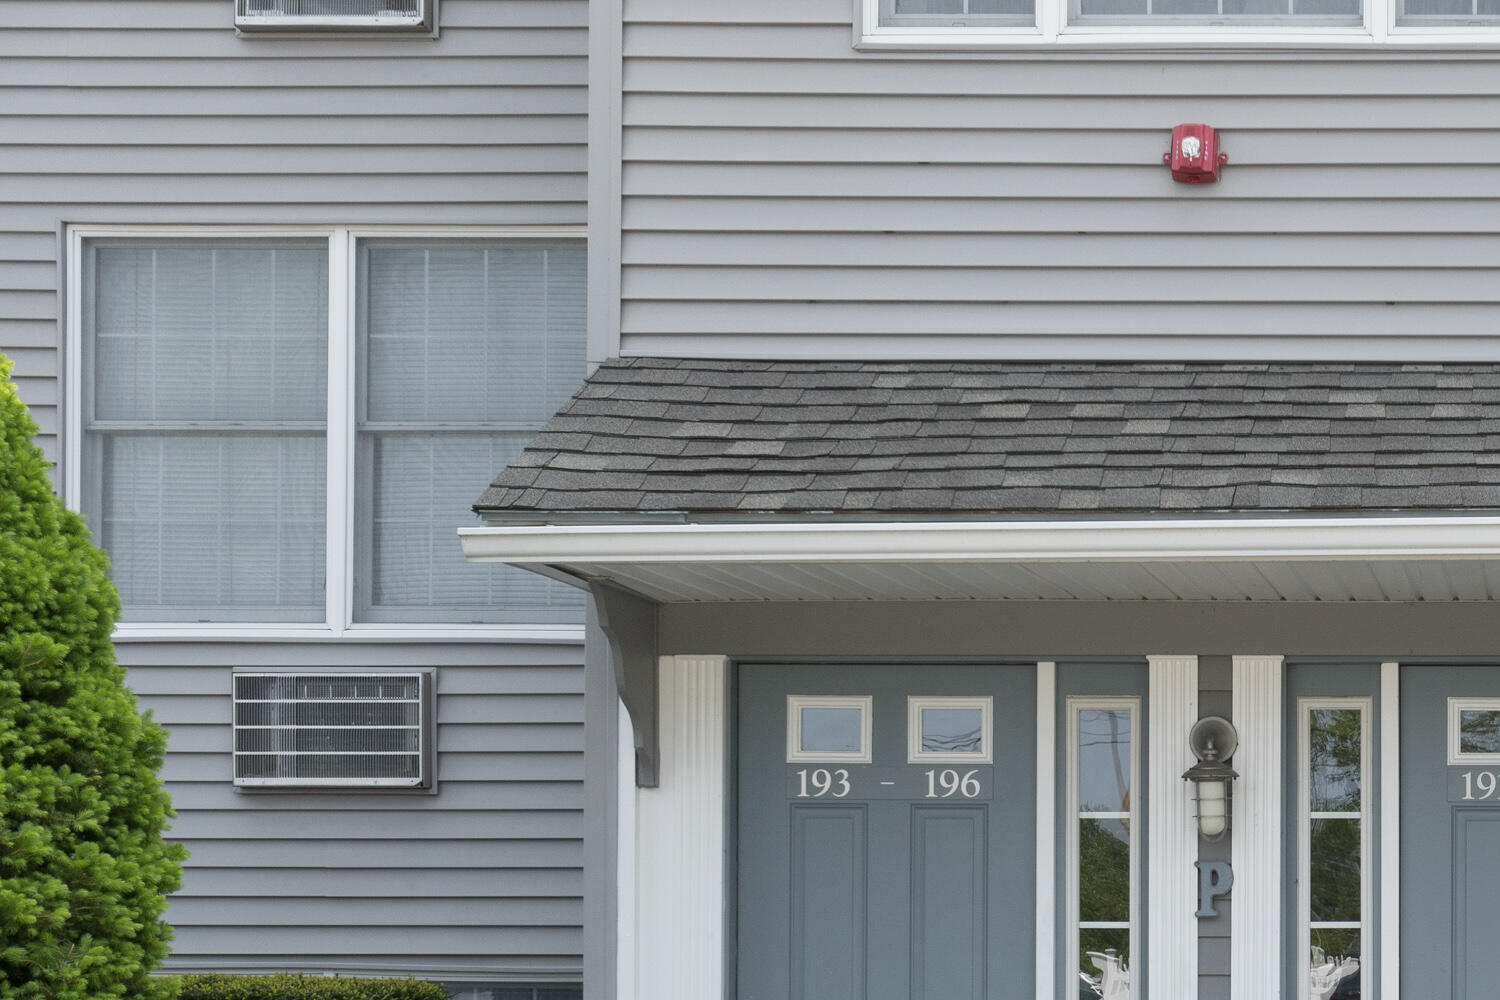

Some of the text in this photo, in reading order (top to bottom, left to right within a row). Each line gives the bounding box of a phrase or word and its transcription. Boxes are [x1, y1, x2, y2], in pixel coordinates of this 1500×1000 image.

[796, 768, 851, 798] 193
[925, 768, 981, 798] 196
[1194, 861, 1234, 918] P
